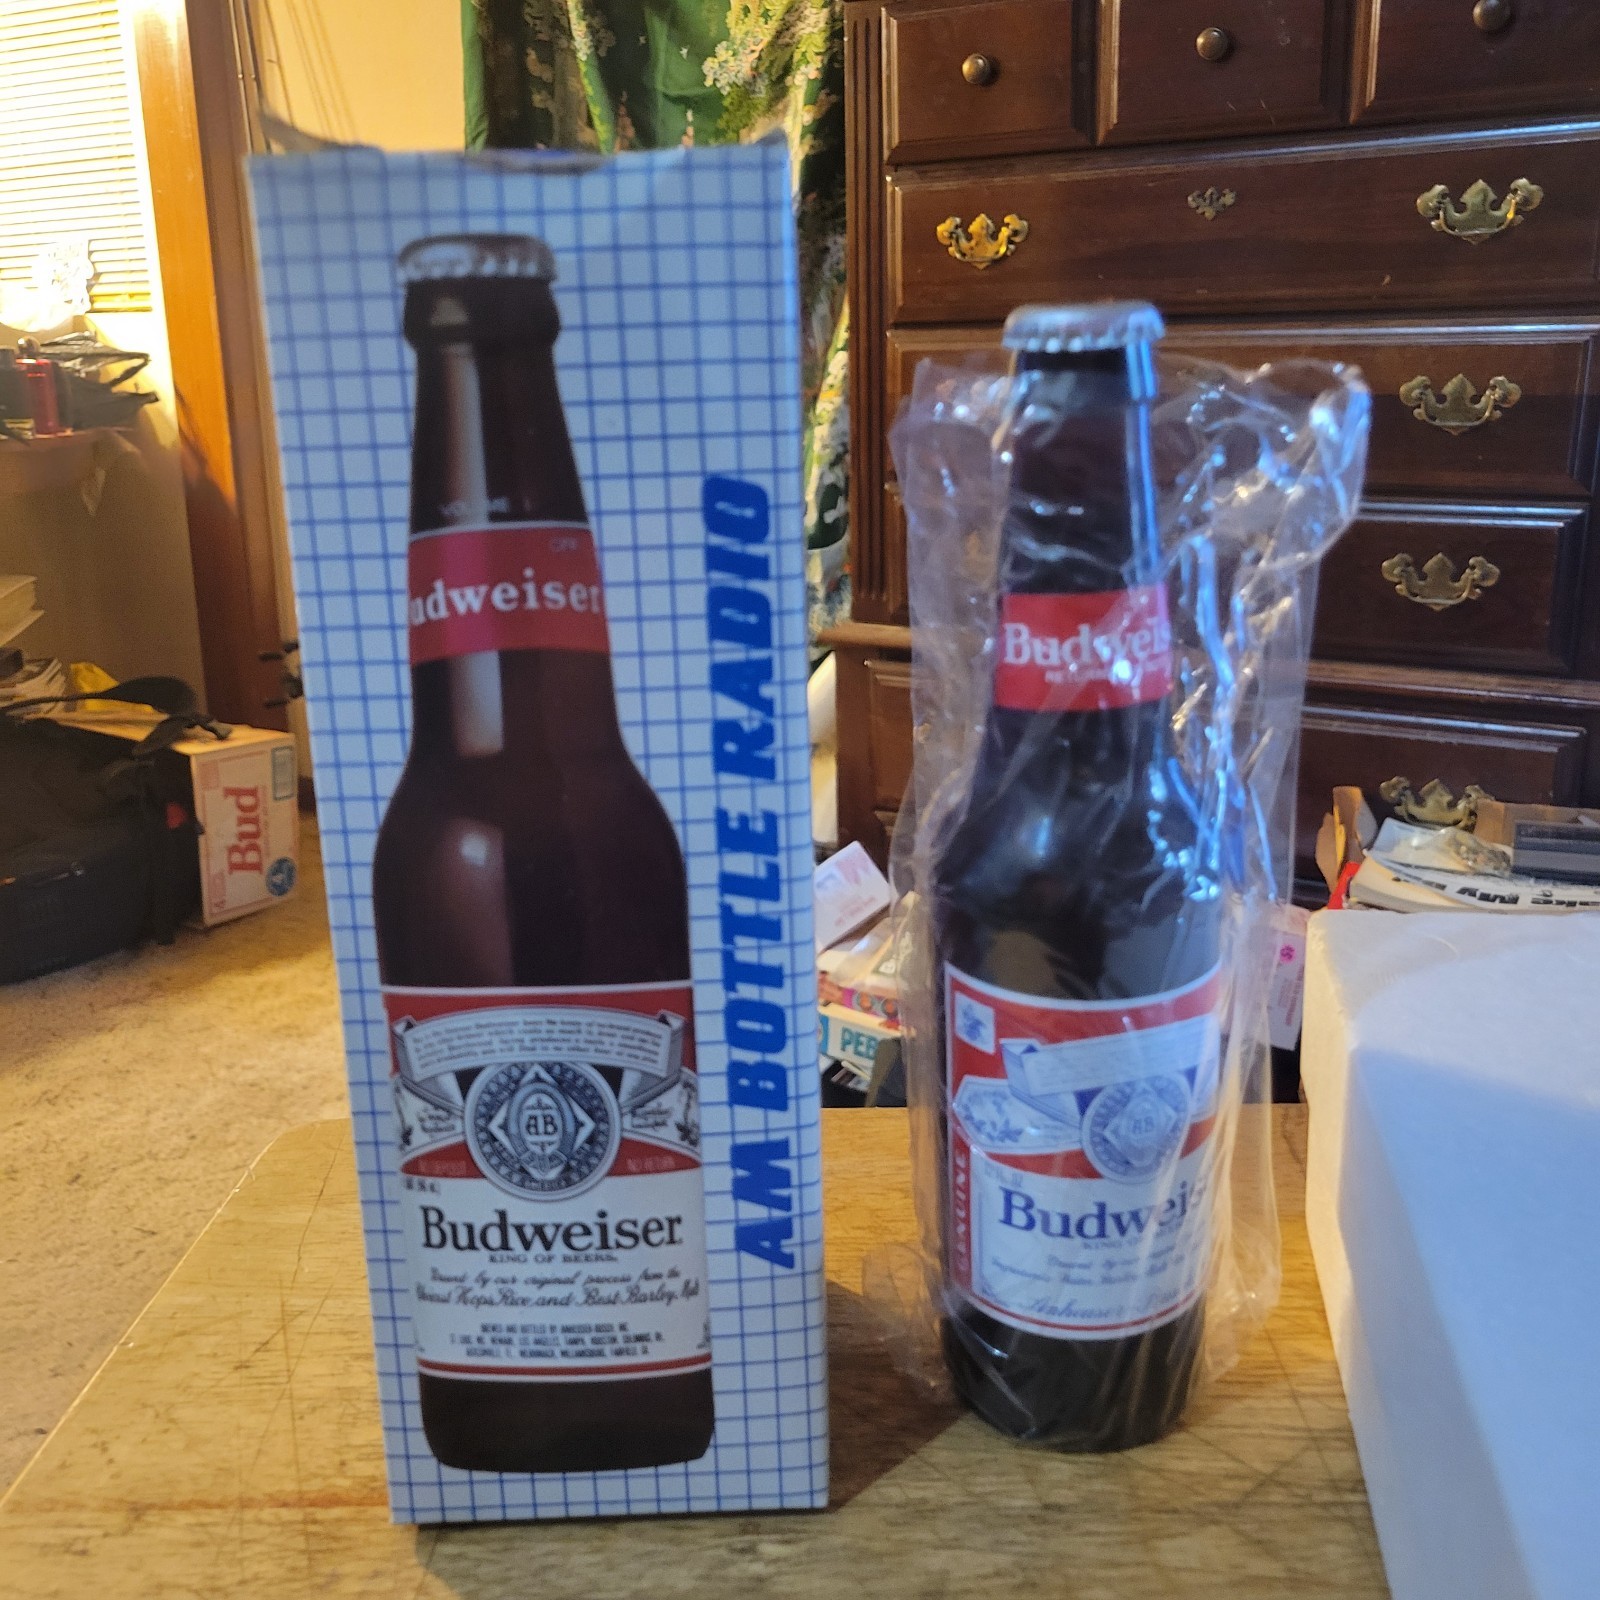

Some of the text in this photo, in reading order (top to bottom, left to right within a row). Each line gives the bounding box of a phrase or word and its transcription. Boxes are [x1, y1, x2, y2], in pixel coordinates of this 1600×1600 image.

[223, 785, 264, 876] Bud
[702, 474, 795, 1270] AM BOTTLE RADIO
[419, 1205, 684, 1251] Budweiser
